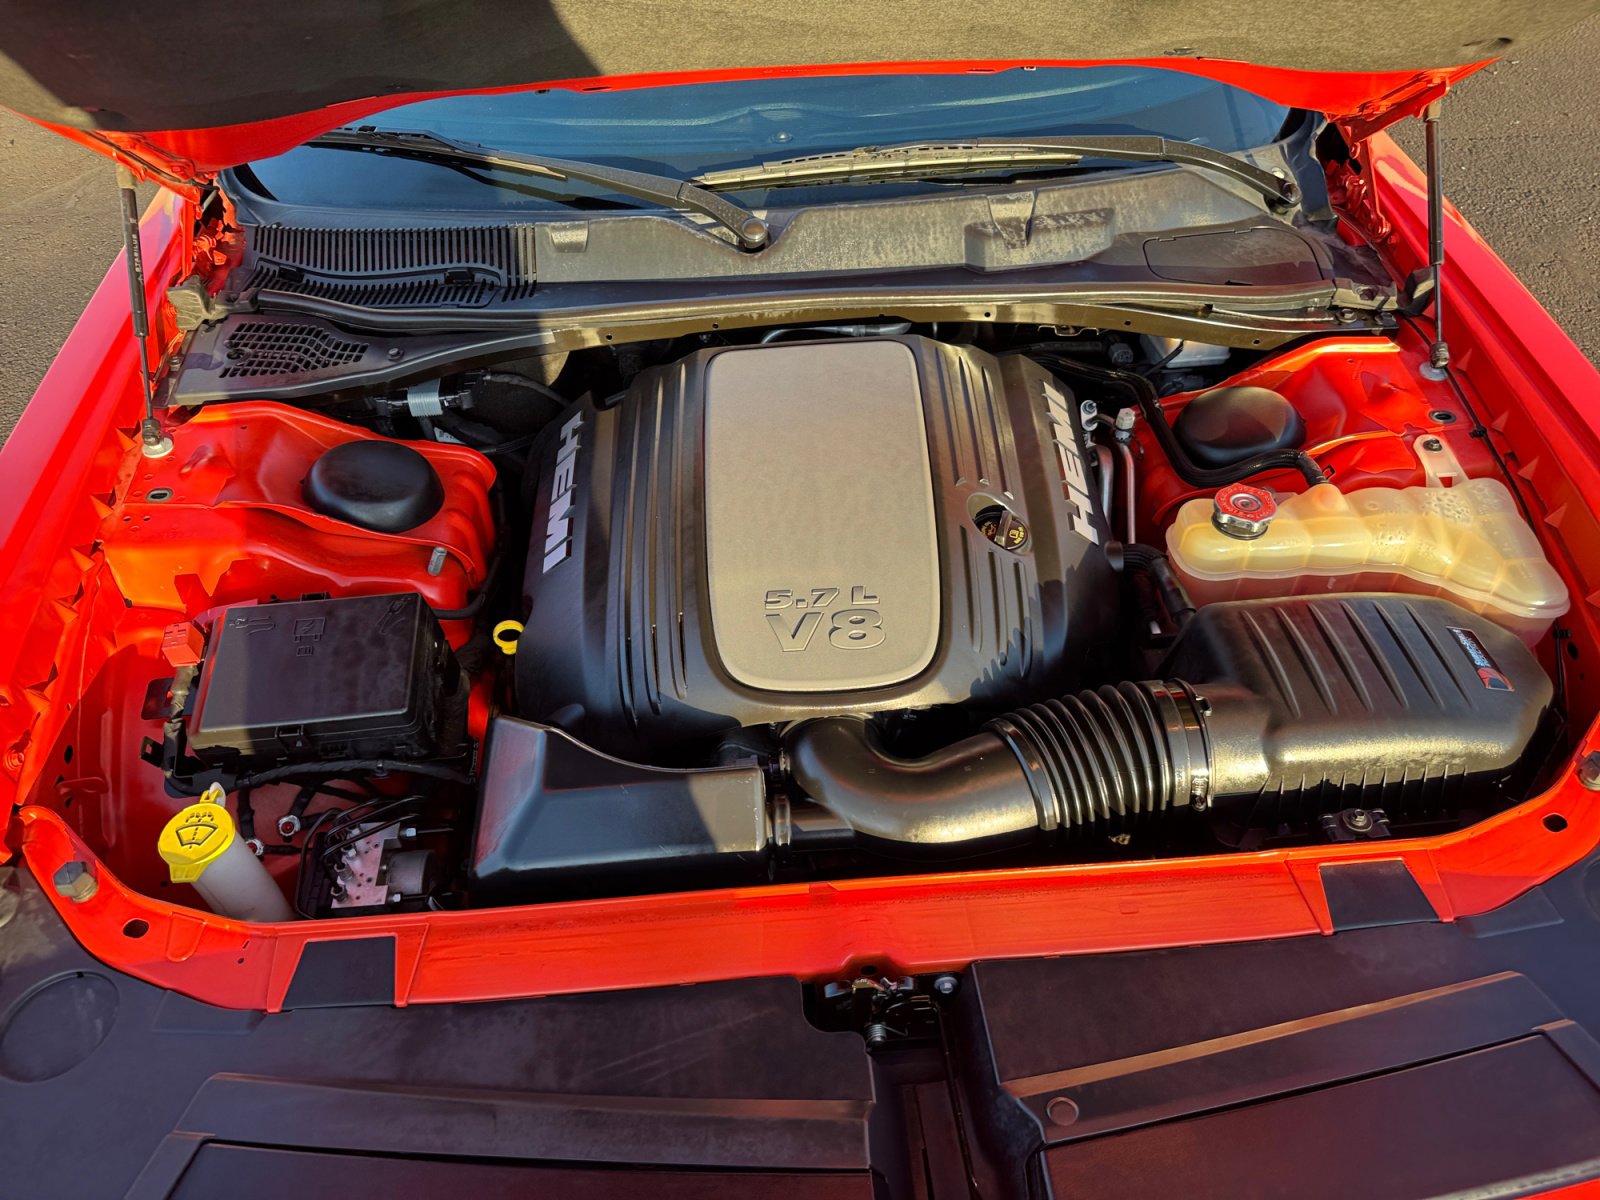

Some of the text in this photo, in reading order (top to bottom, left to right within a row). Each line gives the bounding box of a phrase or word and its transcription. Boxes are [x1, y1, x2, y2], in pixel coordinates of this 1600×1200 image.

[542, 411, 582, 573] HEMI
[1043, 382, 1098, 545] HEMI
[765, 609, 887, 652] V8
